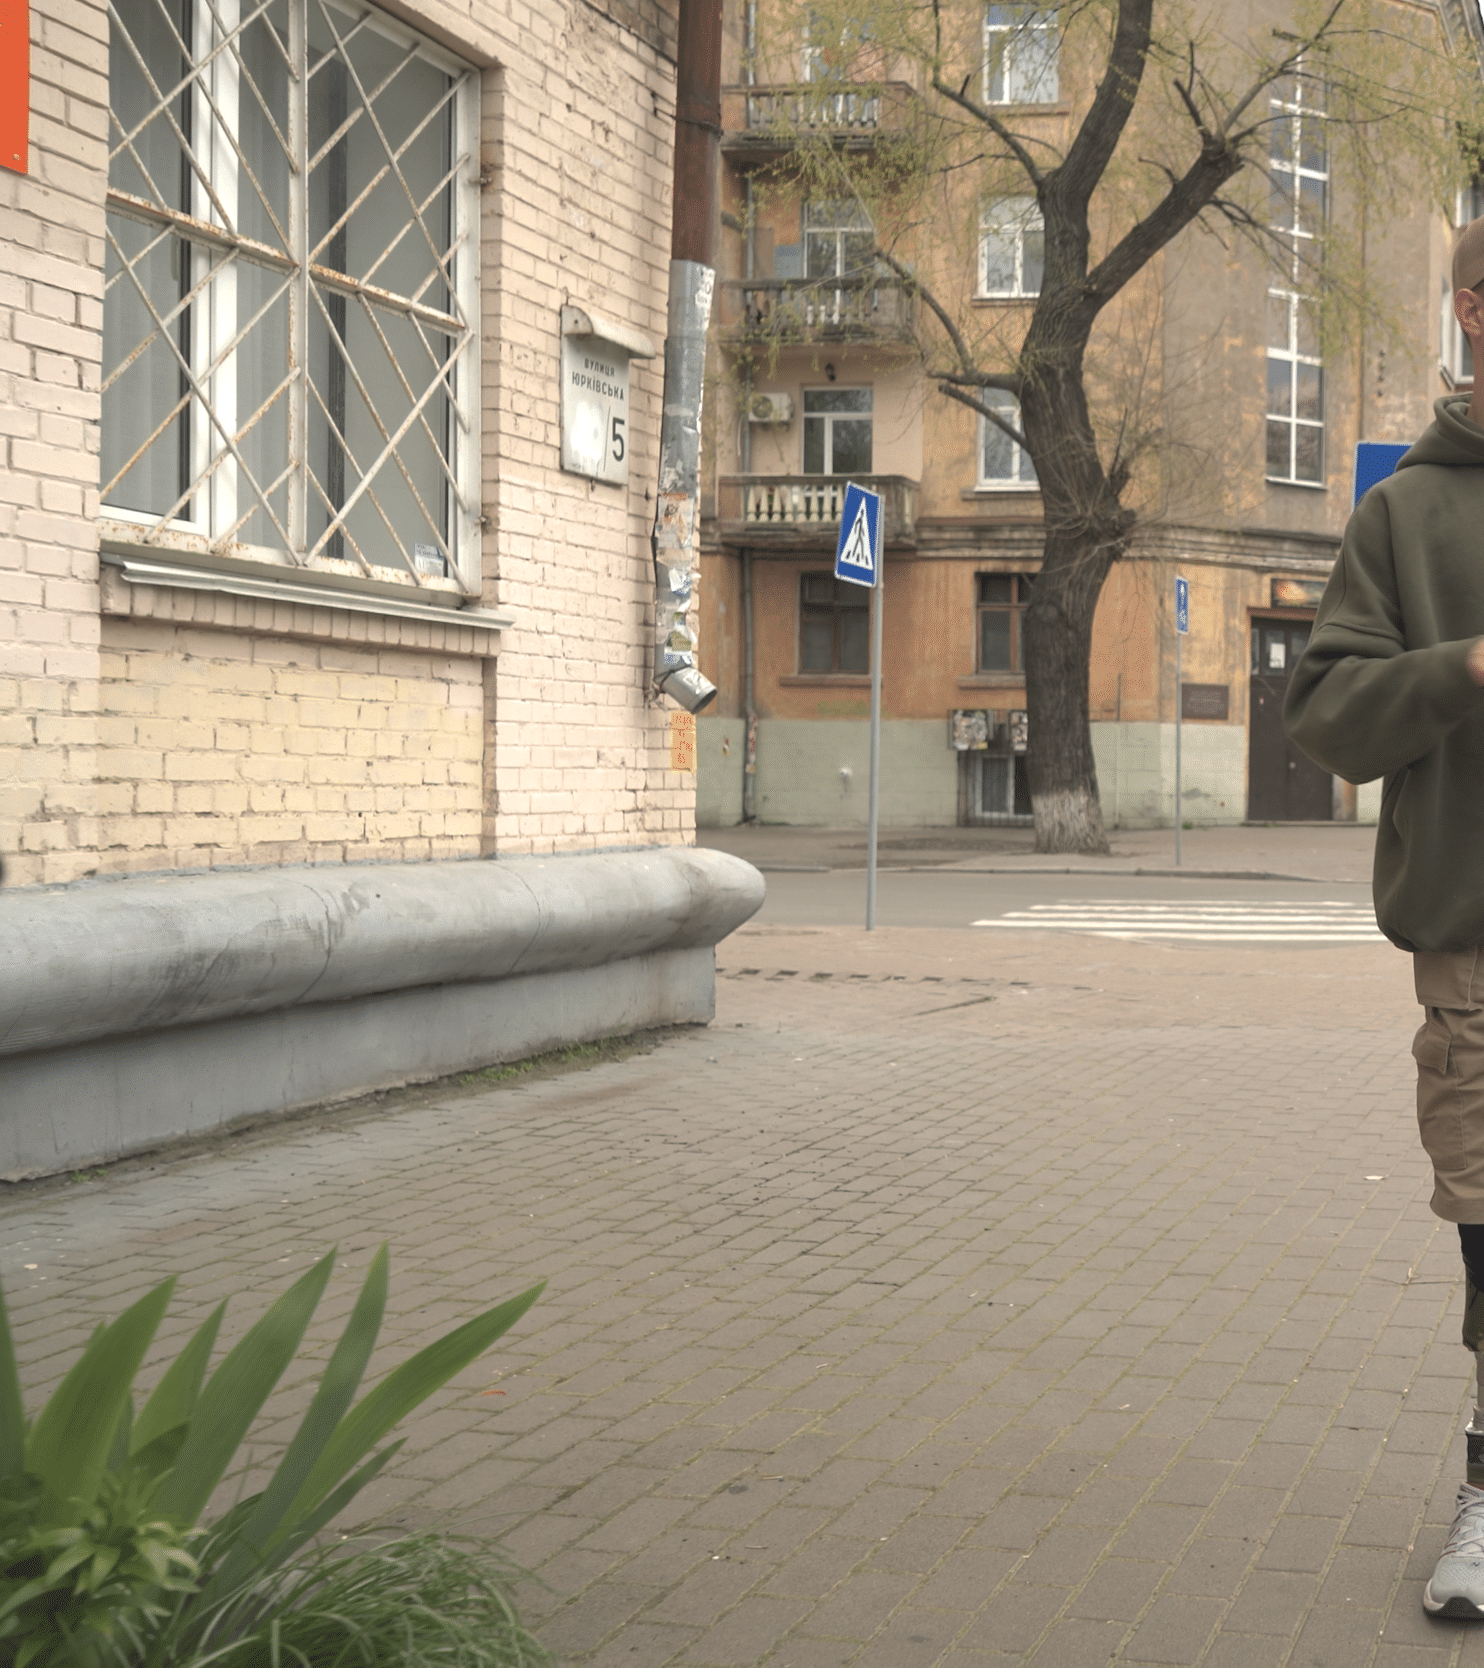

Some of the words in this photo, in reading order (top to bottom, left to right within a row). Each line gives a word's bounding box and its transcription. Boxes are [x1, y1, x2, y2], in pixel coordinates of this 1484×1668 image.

[585, 358, 615, 377] ВУЛИЦЯ
[572, 371, 624, 400] ЮРКІВСЬКА
[612, 417, 625, 462] 5
